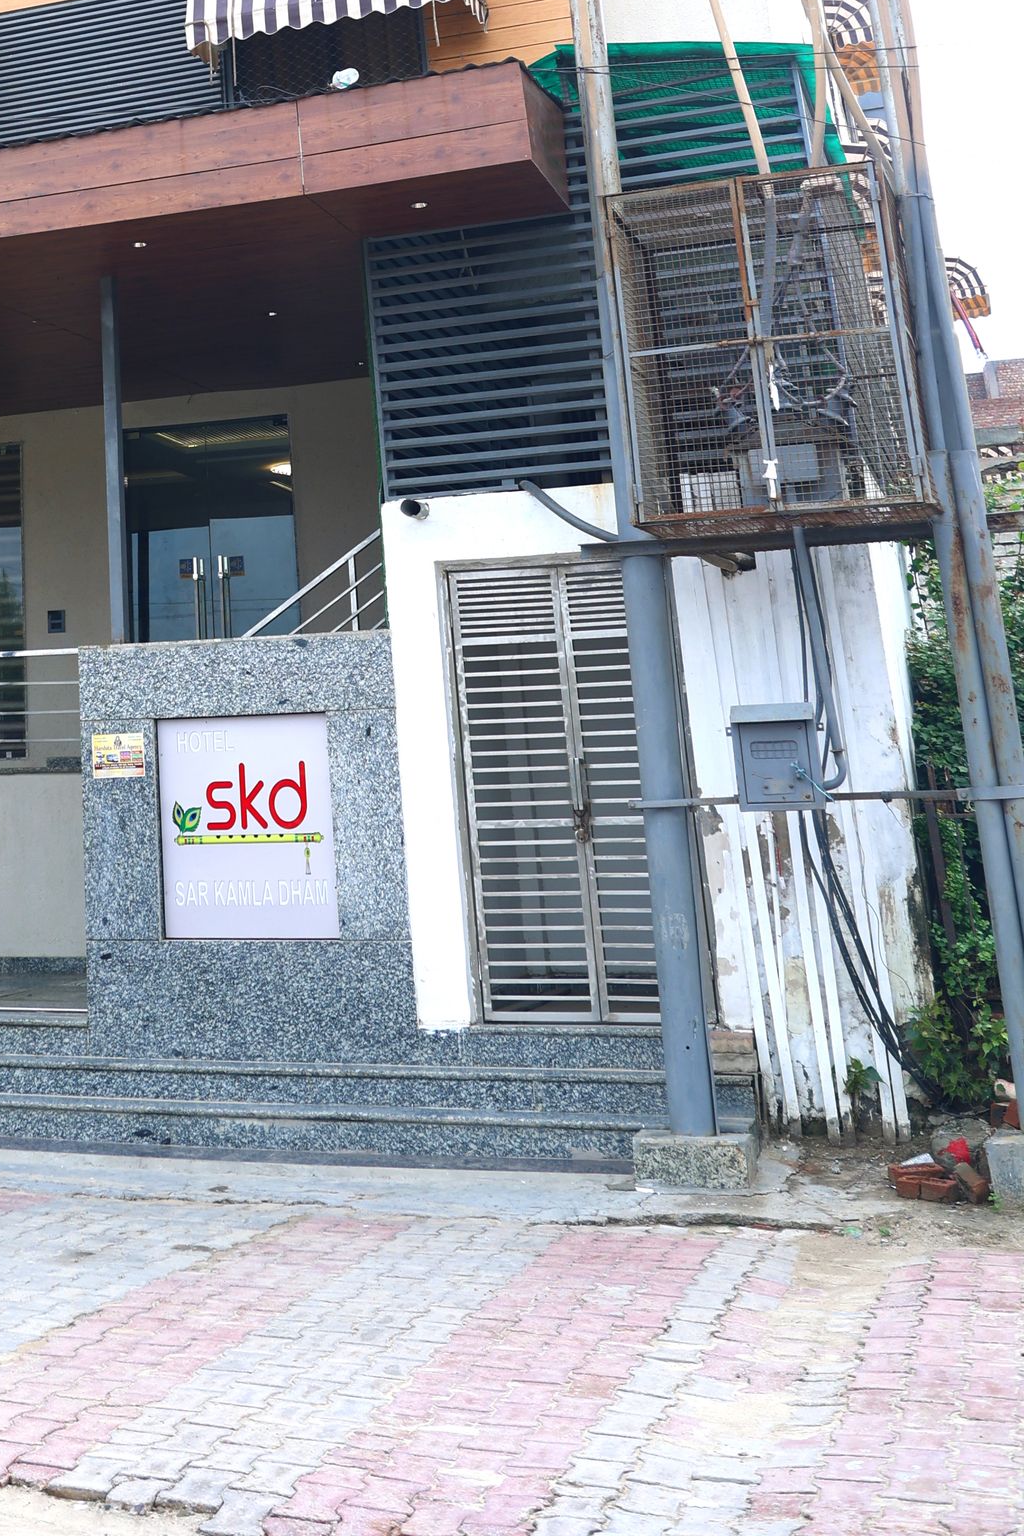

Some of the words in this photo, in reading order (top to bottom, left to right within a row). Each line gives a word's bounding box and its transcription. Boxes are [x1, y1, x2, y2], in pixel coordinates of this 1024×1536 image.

[176, 730, 234, 753] HOTEL
[206, 761, 307, 831] skd
[175, 880, 209, 906] SAR
[214, 880, 274, 906] KAMLA
[278, 879, 329, 906] DHAM
